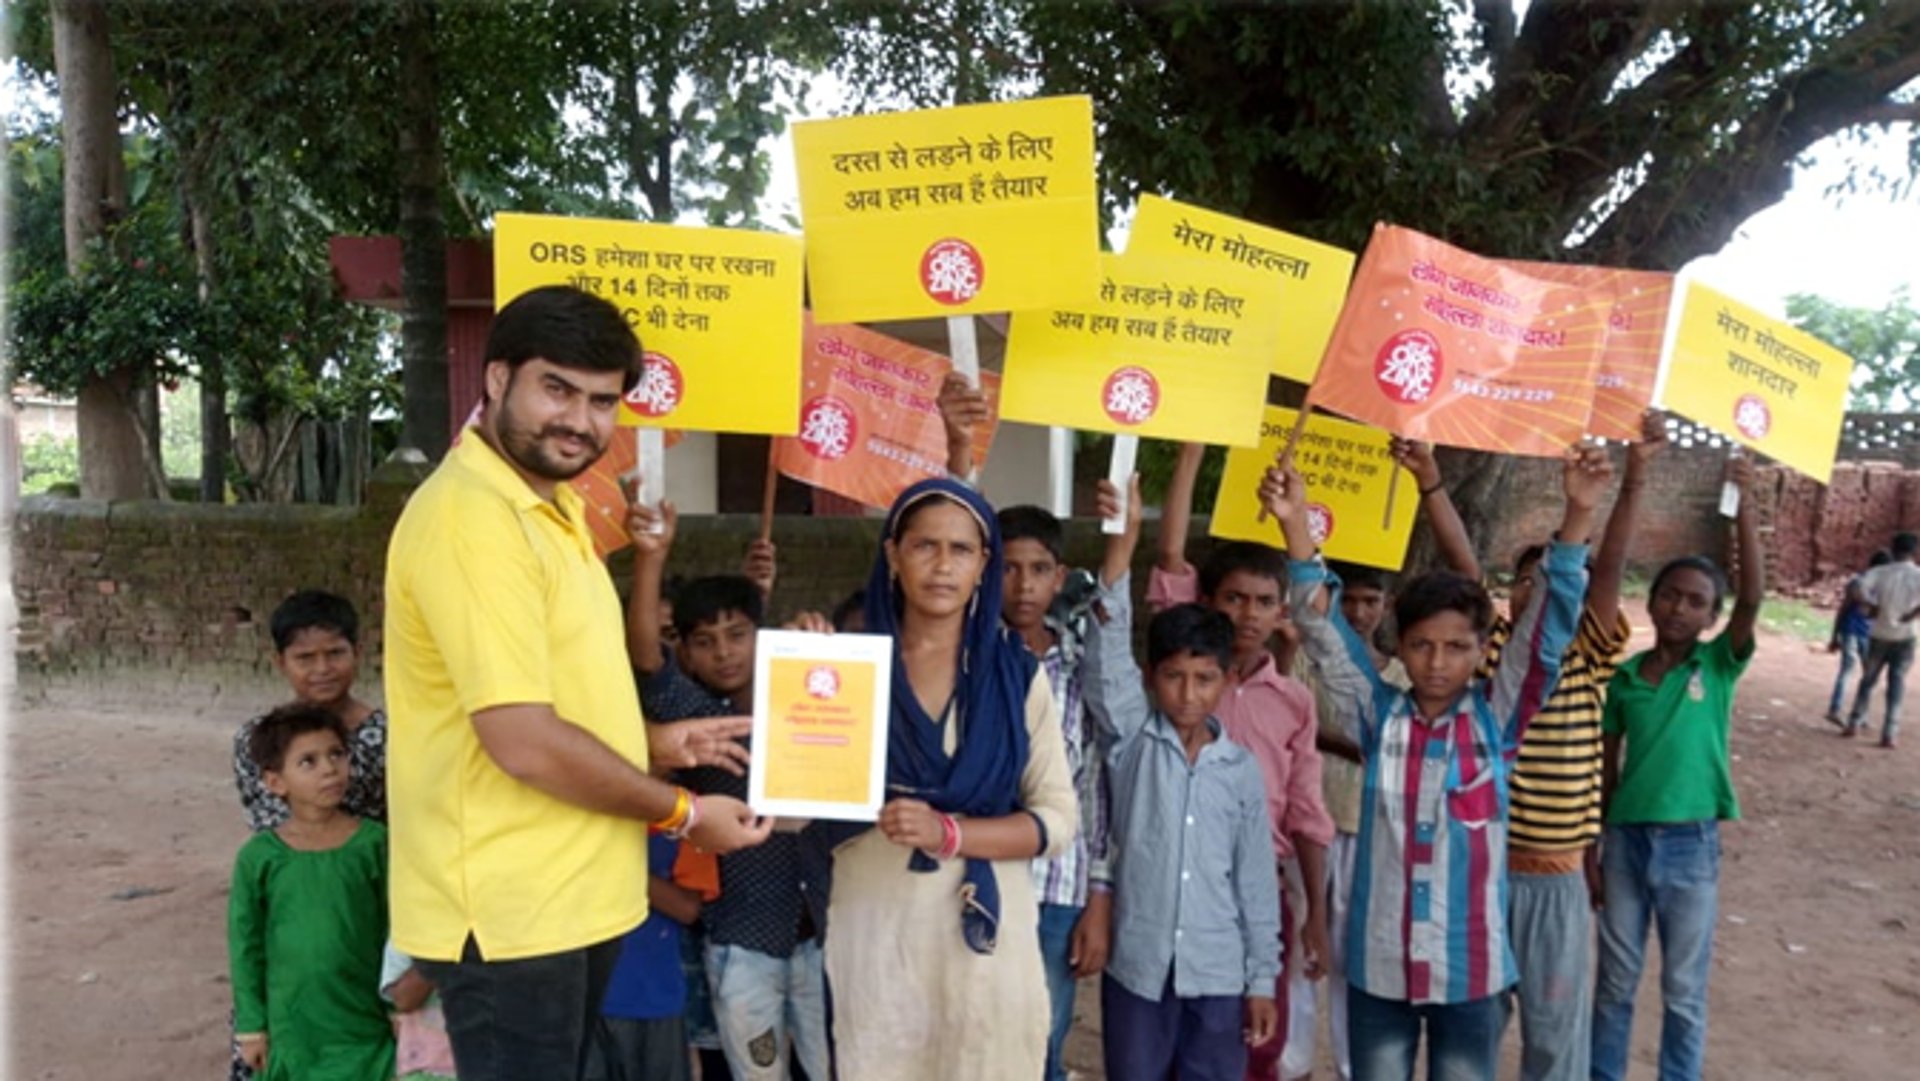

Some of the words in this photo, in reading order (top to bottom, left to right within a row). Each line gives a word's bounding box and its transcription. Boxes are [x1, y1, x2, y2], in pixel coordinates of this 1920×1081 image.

[832, 151, 881, 175] दस्त
[886, 142, 908, 170] से
[978, 133, 1002, 163] के
[1007, 130, 1054, 162] लिए
[844, 189, 882, 211] अब
[887, 186, 921, 211] हम
[926, 182, 963, 204] सब
[991, 172, 1048, 199] तैयार
[529, 241, 587, 266] ORS
[595, 242, 650, 269] हमेशा
[654, 252, 684, 271] घर
[689, 254, 716, 273] पर
[721, 256, 776, 277] रखना
[1173, 219, 1216, 253] मेरा
[1223, 237, 1310, 279] मोहल्ला
[610, 277, 637, 296] 14
[646, 273, 690, 300] दिनों
[695, 284, 730, 302] तक
[1100, 277, 1117, 302] से
[1177, 286, 1199, 310] के
[1203, 287, 1245, 319] लिए
[646, 304, 668, 329] भी
[673, 308, 710, 332] देना
[1051, 310, 1085, 330] अब
[1089, 315, 1120, 335] हम
[1125, 318, 1158, 338] सब
[1181, 319, 1233, 346] तैयार
[1717, 306, 1751, 342] मेरा
[1754, 327, 1822, 379] मोहल्ला
[1728, 350, 1798, 400] शानदार
[1303, 451, 1321, 466] 14
